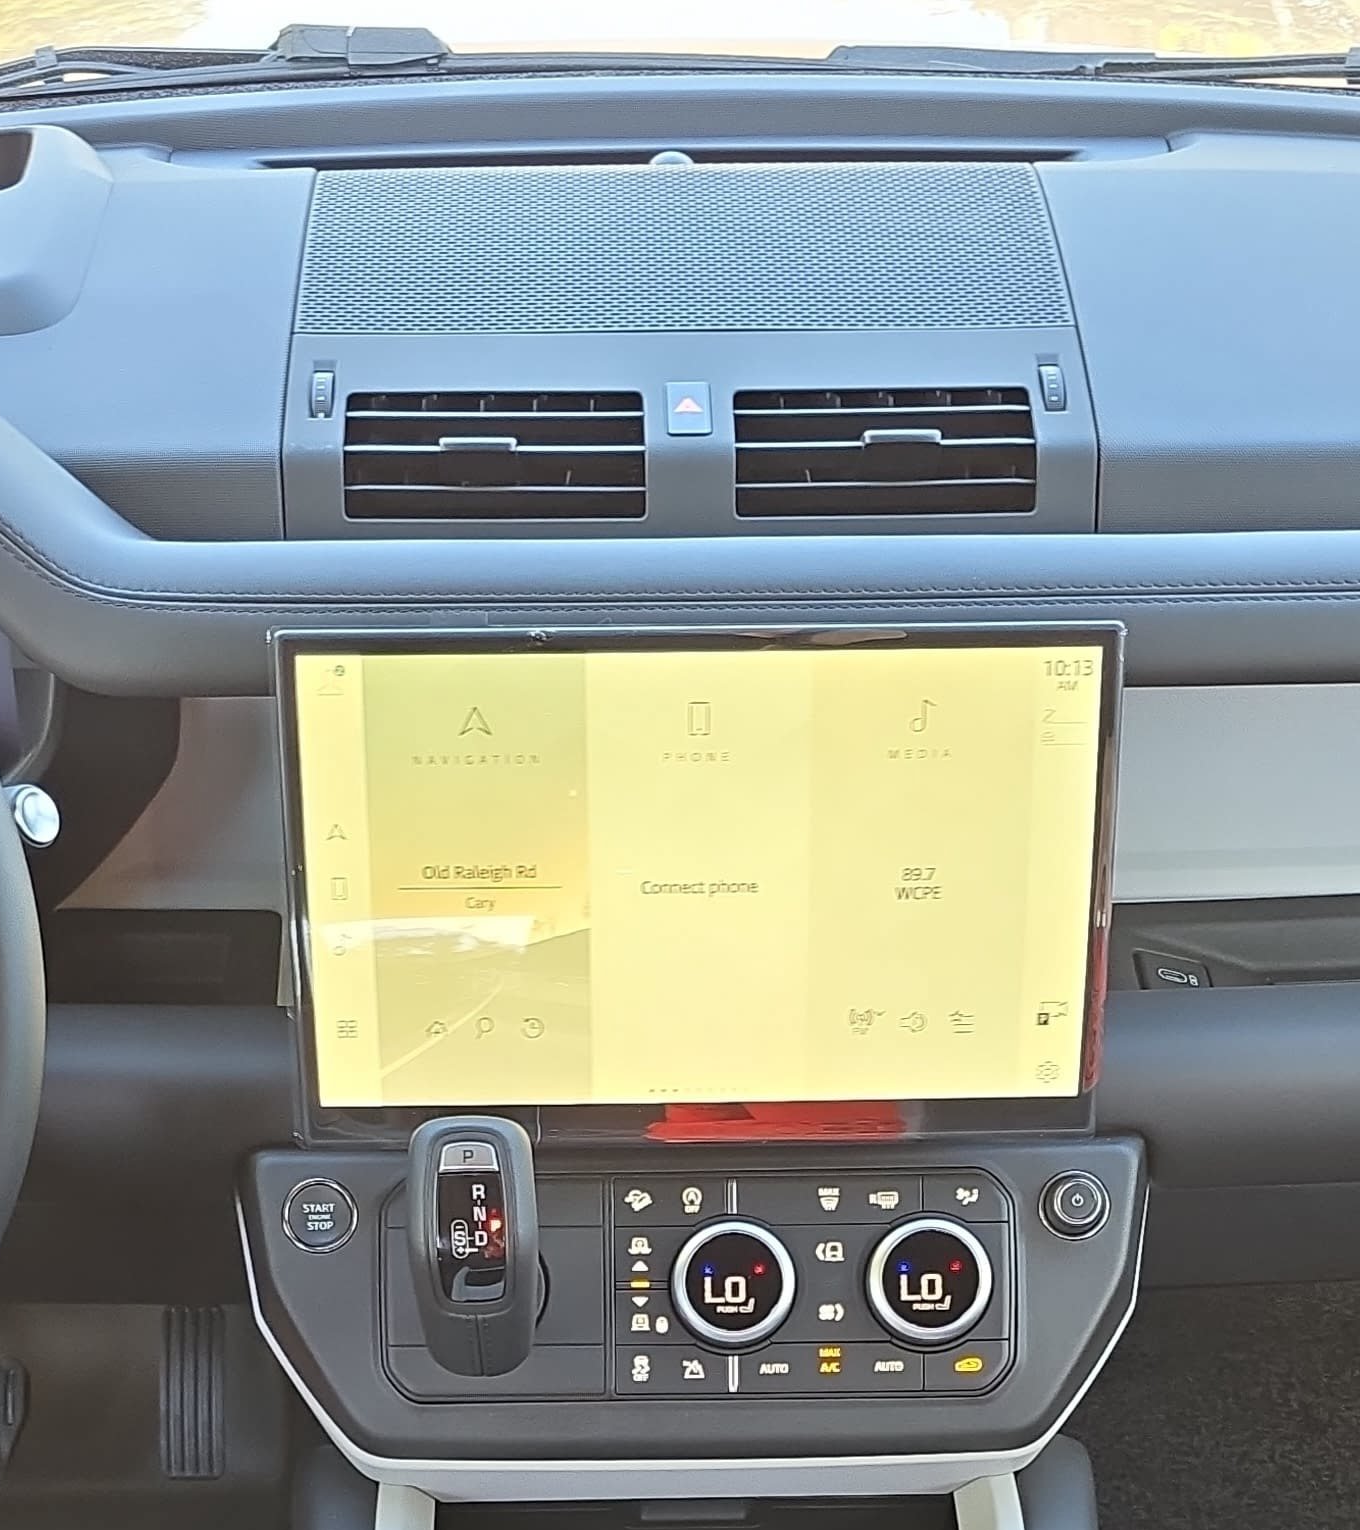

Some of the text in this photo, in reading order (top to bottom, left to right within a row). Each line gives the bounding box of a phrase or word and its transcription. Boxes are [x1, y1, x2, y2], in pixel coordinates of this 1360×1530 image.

[1043, 660, 1094, 676] 10:13
[411, 754, 541, 766] NAVIGATION
[662, 751, 730, 763] PHONE
[887, 748, 953, 760] MEDIA
[421, 863, 538, 883] Old Raleigh Rd
[901, 867, 937, 882] 89.7
[640, 878, 759, 897] Connect phone
[465, 896, 495, 912] Cary
[462, 1149, 475, 1164] P
[471, 1184, 487, 1200] R
[302, 1202, 336, 1213] START
[472, 1206, 487, 1222] N
[306, 1220, 335, 1231] STOP
[453, 1230, 467, 1247] S
[474, 1230, 489, 1247] D
[703, 1275, 747, 1304] LO
[899, 1272, 944, 1302] LO
[758, 1362, 790, 1376] AUTO
[818, 1360, 842, 1374] A/C
[873, 1360, 905, 1373] AUTO
